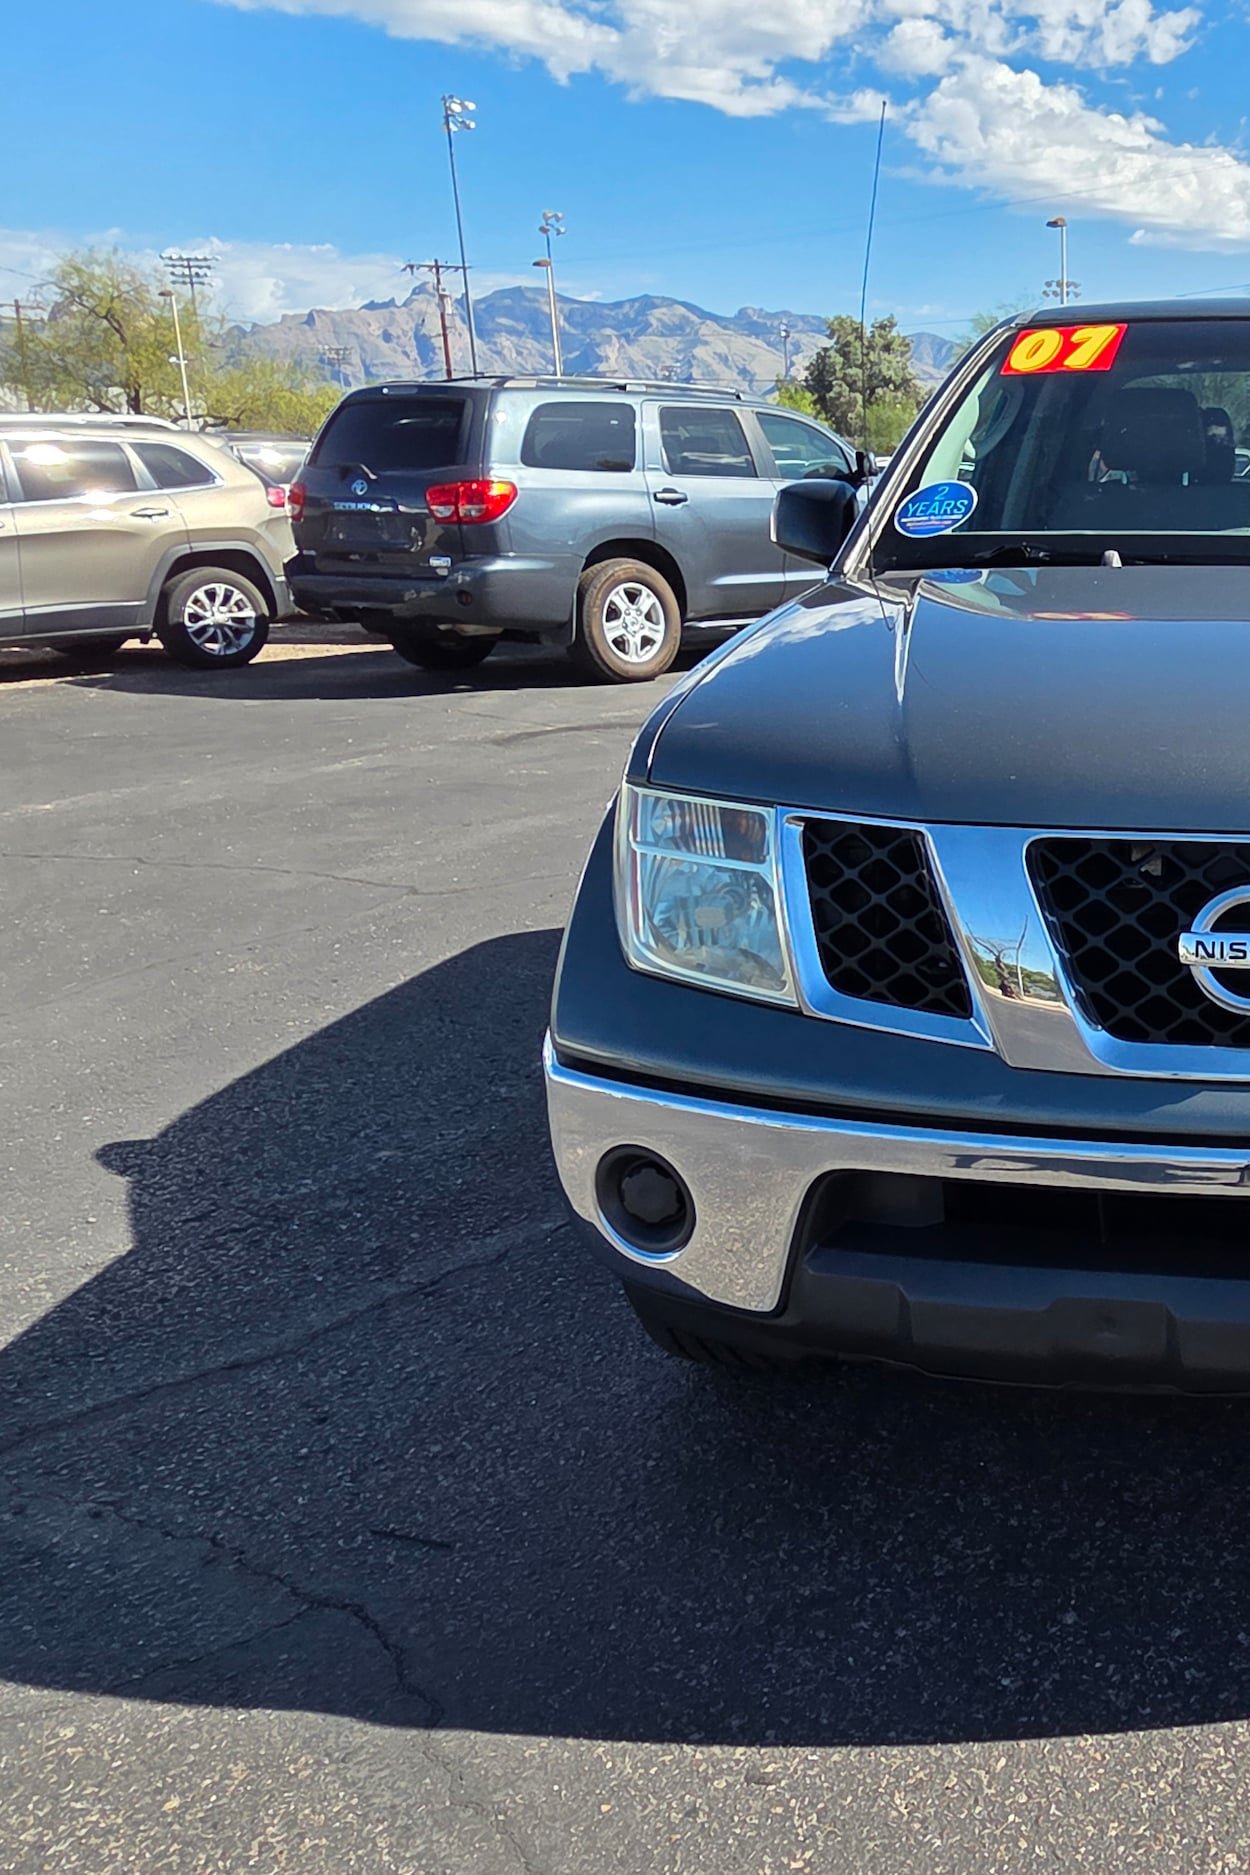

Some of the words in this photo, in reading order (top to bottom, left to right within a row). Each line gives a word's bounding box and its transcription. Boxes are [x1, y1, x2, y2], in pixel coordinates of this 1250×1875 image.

[1009, 326, 1119, 372] 07
[934, 486, 949, 500] 2
[907, 499, 968, 517] YEARS
